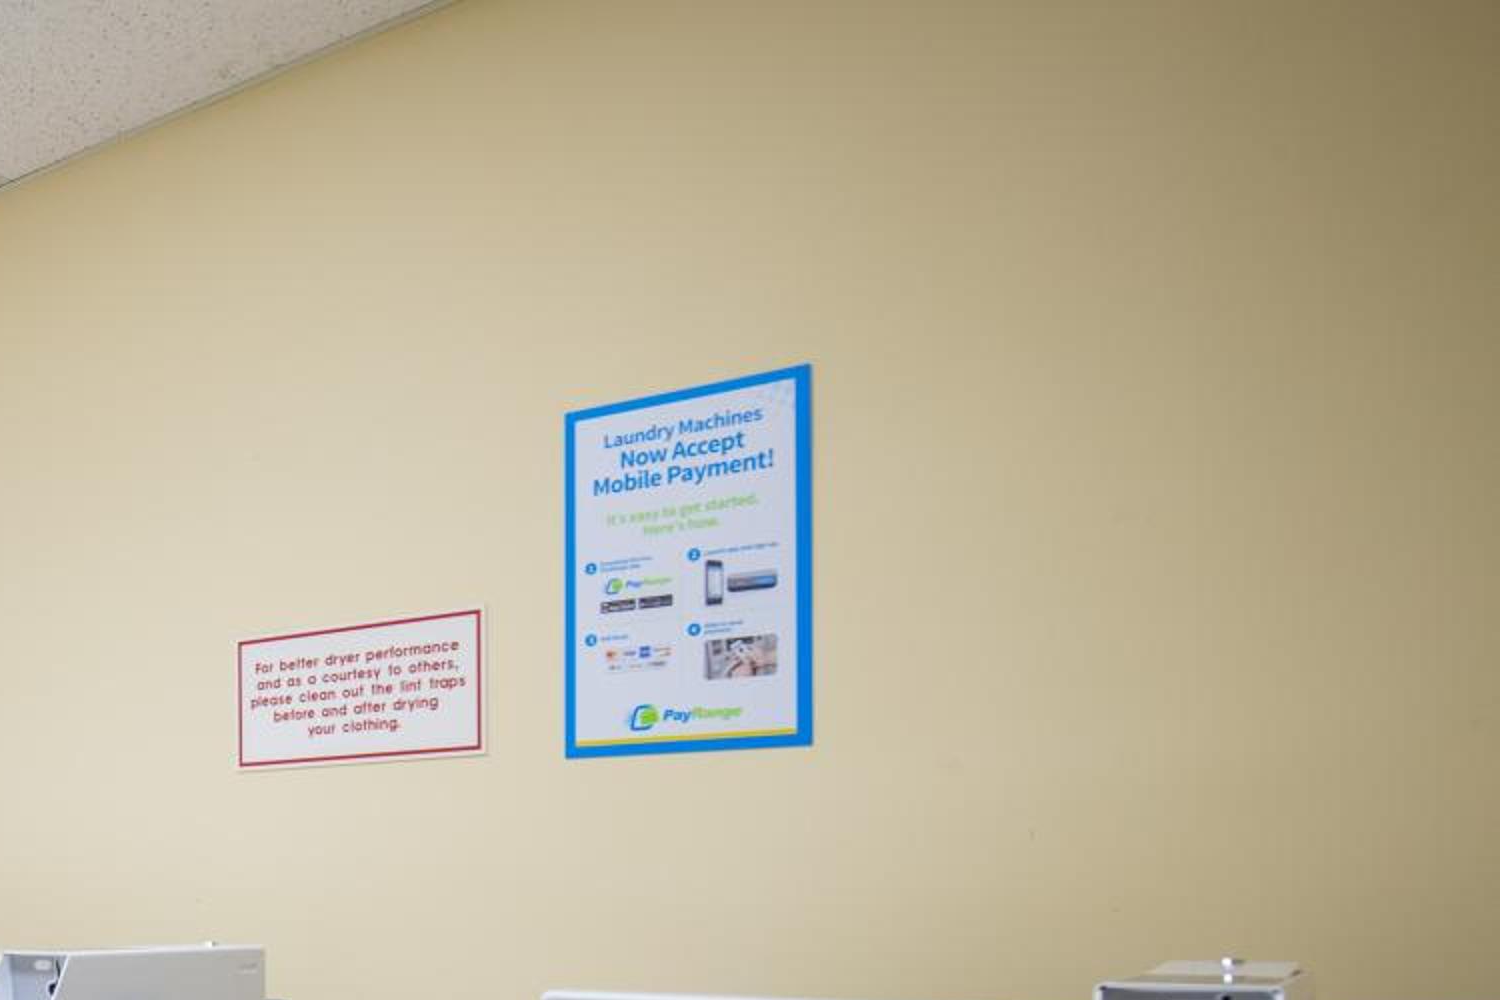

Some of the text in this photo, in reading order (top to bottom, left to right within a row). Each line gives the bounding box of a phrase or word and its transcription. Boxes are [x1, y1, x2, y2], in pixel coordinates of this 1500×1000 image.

[603, 407, 763, 449] Laundry Machines
[620, 431, 746, 469] Now Accept
[593, 448, 775, 496] Mobile Payment!
[255, 641, 460, 675] For better dryer performance
[257, 658, 460, 691] and as a courtesy to others,
[251, 676, 467, 709] please clean out the lint traps
[273, 696, 439, 723] before and after drying
[307, 717, 400, 738] your clothing.
